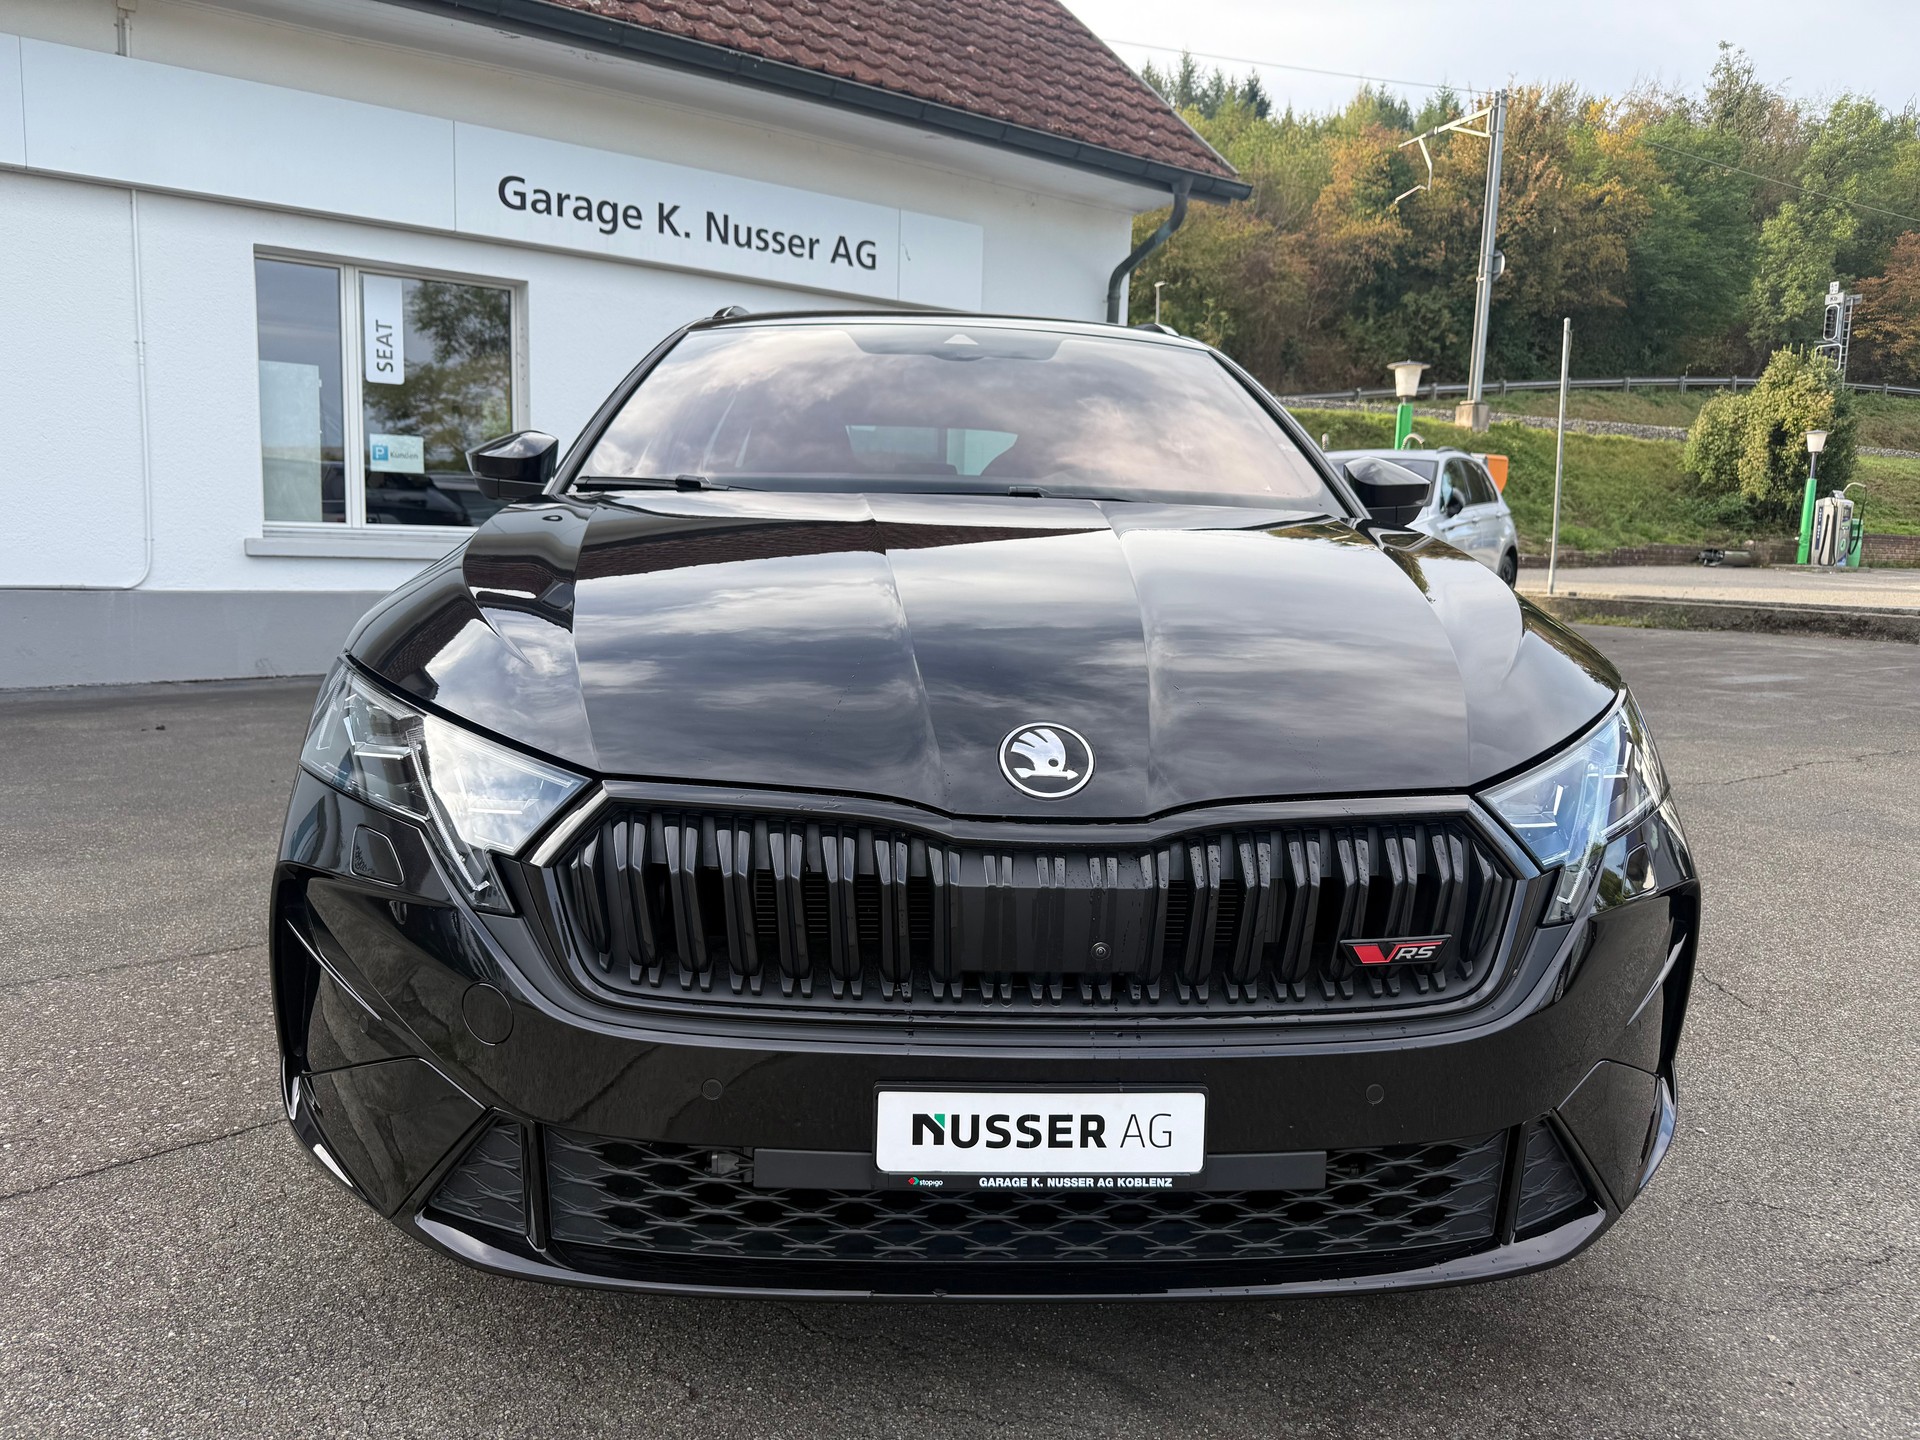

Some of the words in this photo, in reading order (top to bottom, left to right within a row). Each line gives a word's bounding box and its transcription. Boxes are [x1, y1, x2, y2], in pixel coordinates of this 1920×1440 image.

[498, 175, 643, 235] Garage
[657, 202, 691, 239] K.
[705, 211, 820, 260] Nusser
[830, 235, 877, 271] AG
[376, 319, 394, 373] SEAT
[911, 1113, 1108, 1149] NUSSER
[1119, 1113, 1173, 1149] AG
[979, 1177, 1028, 1188] GARAGE
[1031, 1177, 1044, 1188] K.
[1047, 1177, 1094, 1188] NUSSER
[1097, 1177, 1114, 1188] AG
[1117, 1177, 1173, 1188] KOBLENZ
